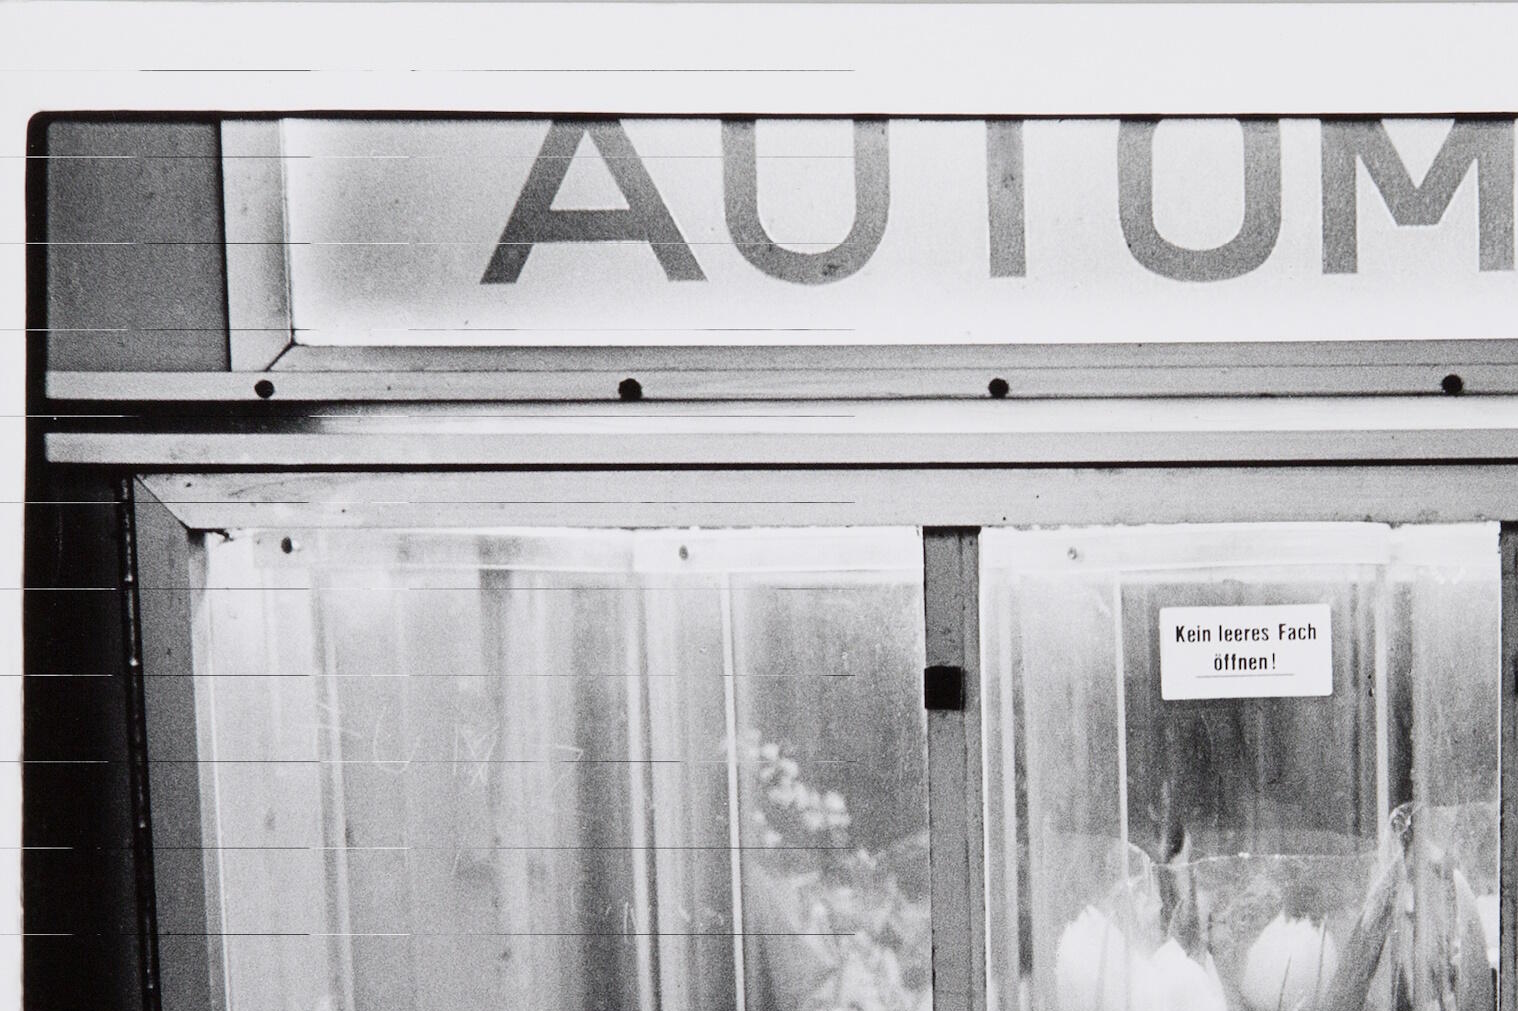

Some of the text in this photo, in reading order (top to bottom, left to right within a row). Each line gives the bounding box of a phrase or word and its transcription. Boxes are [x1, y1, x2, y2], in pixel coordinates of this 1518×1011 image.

[1175, 624, 1317, 642] Kein leeres Fach
[1213, 653, 1277, 671] öffnen!
